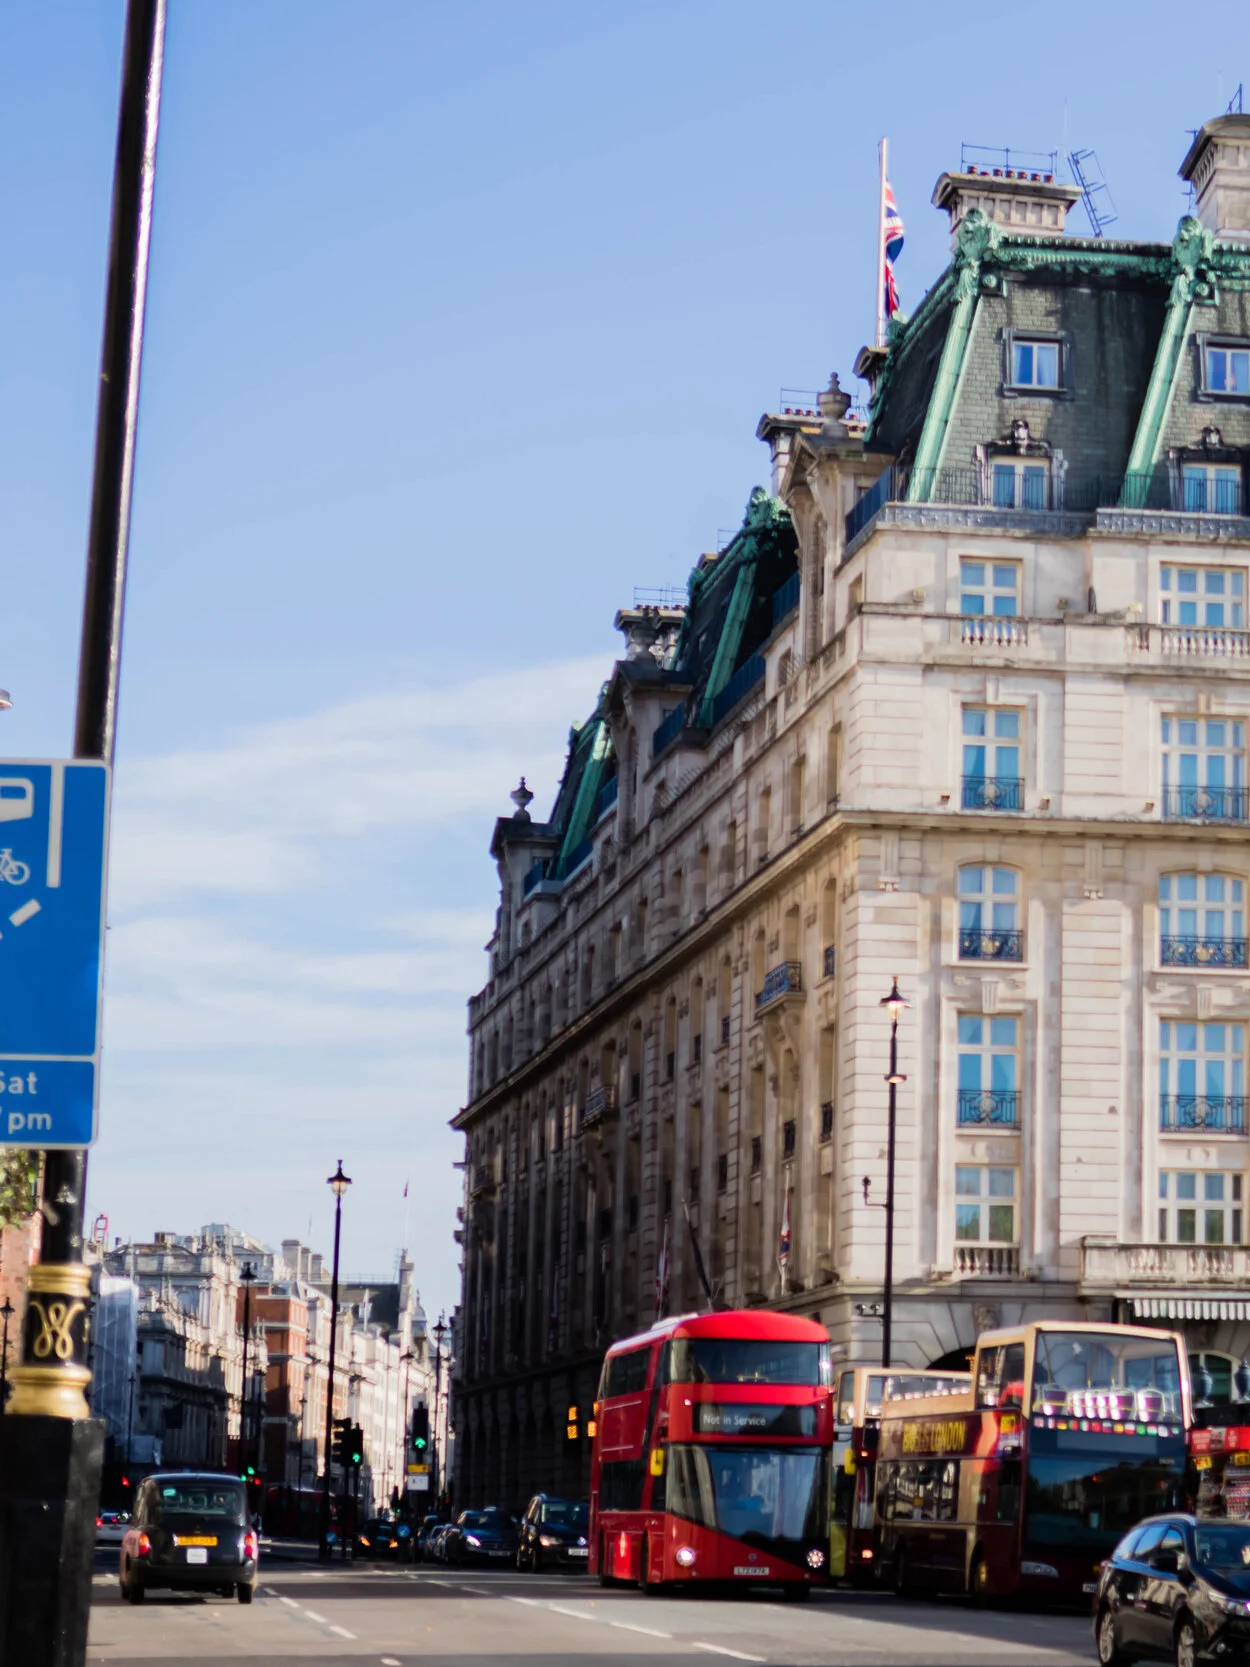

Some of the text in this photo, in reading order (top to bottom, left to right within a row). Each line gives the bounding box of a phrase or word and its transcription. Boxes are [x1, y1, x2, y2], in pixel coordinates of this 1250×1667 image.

[8, 1112, 52, 1135] pm
[703, 1415, 766, 1427] Not in Service
